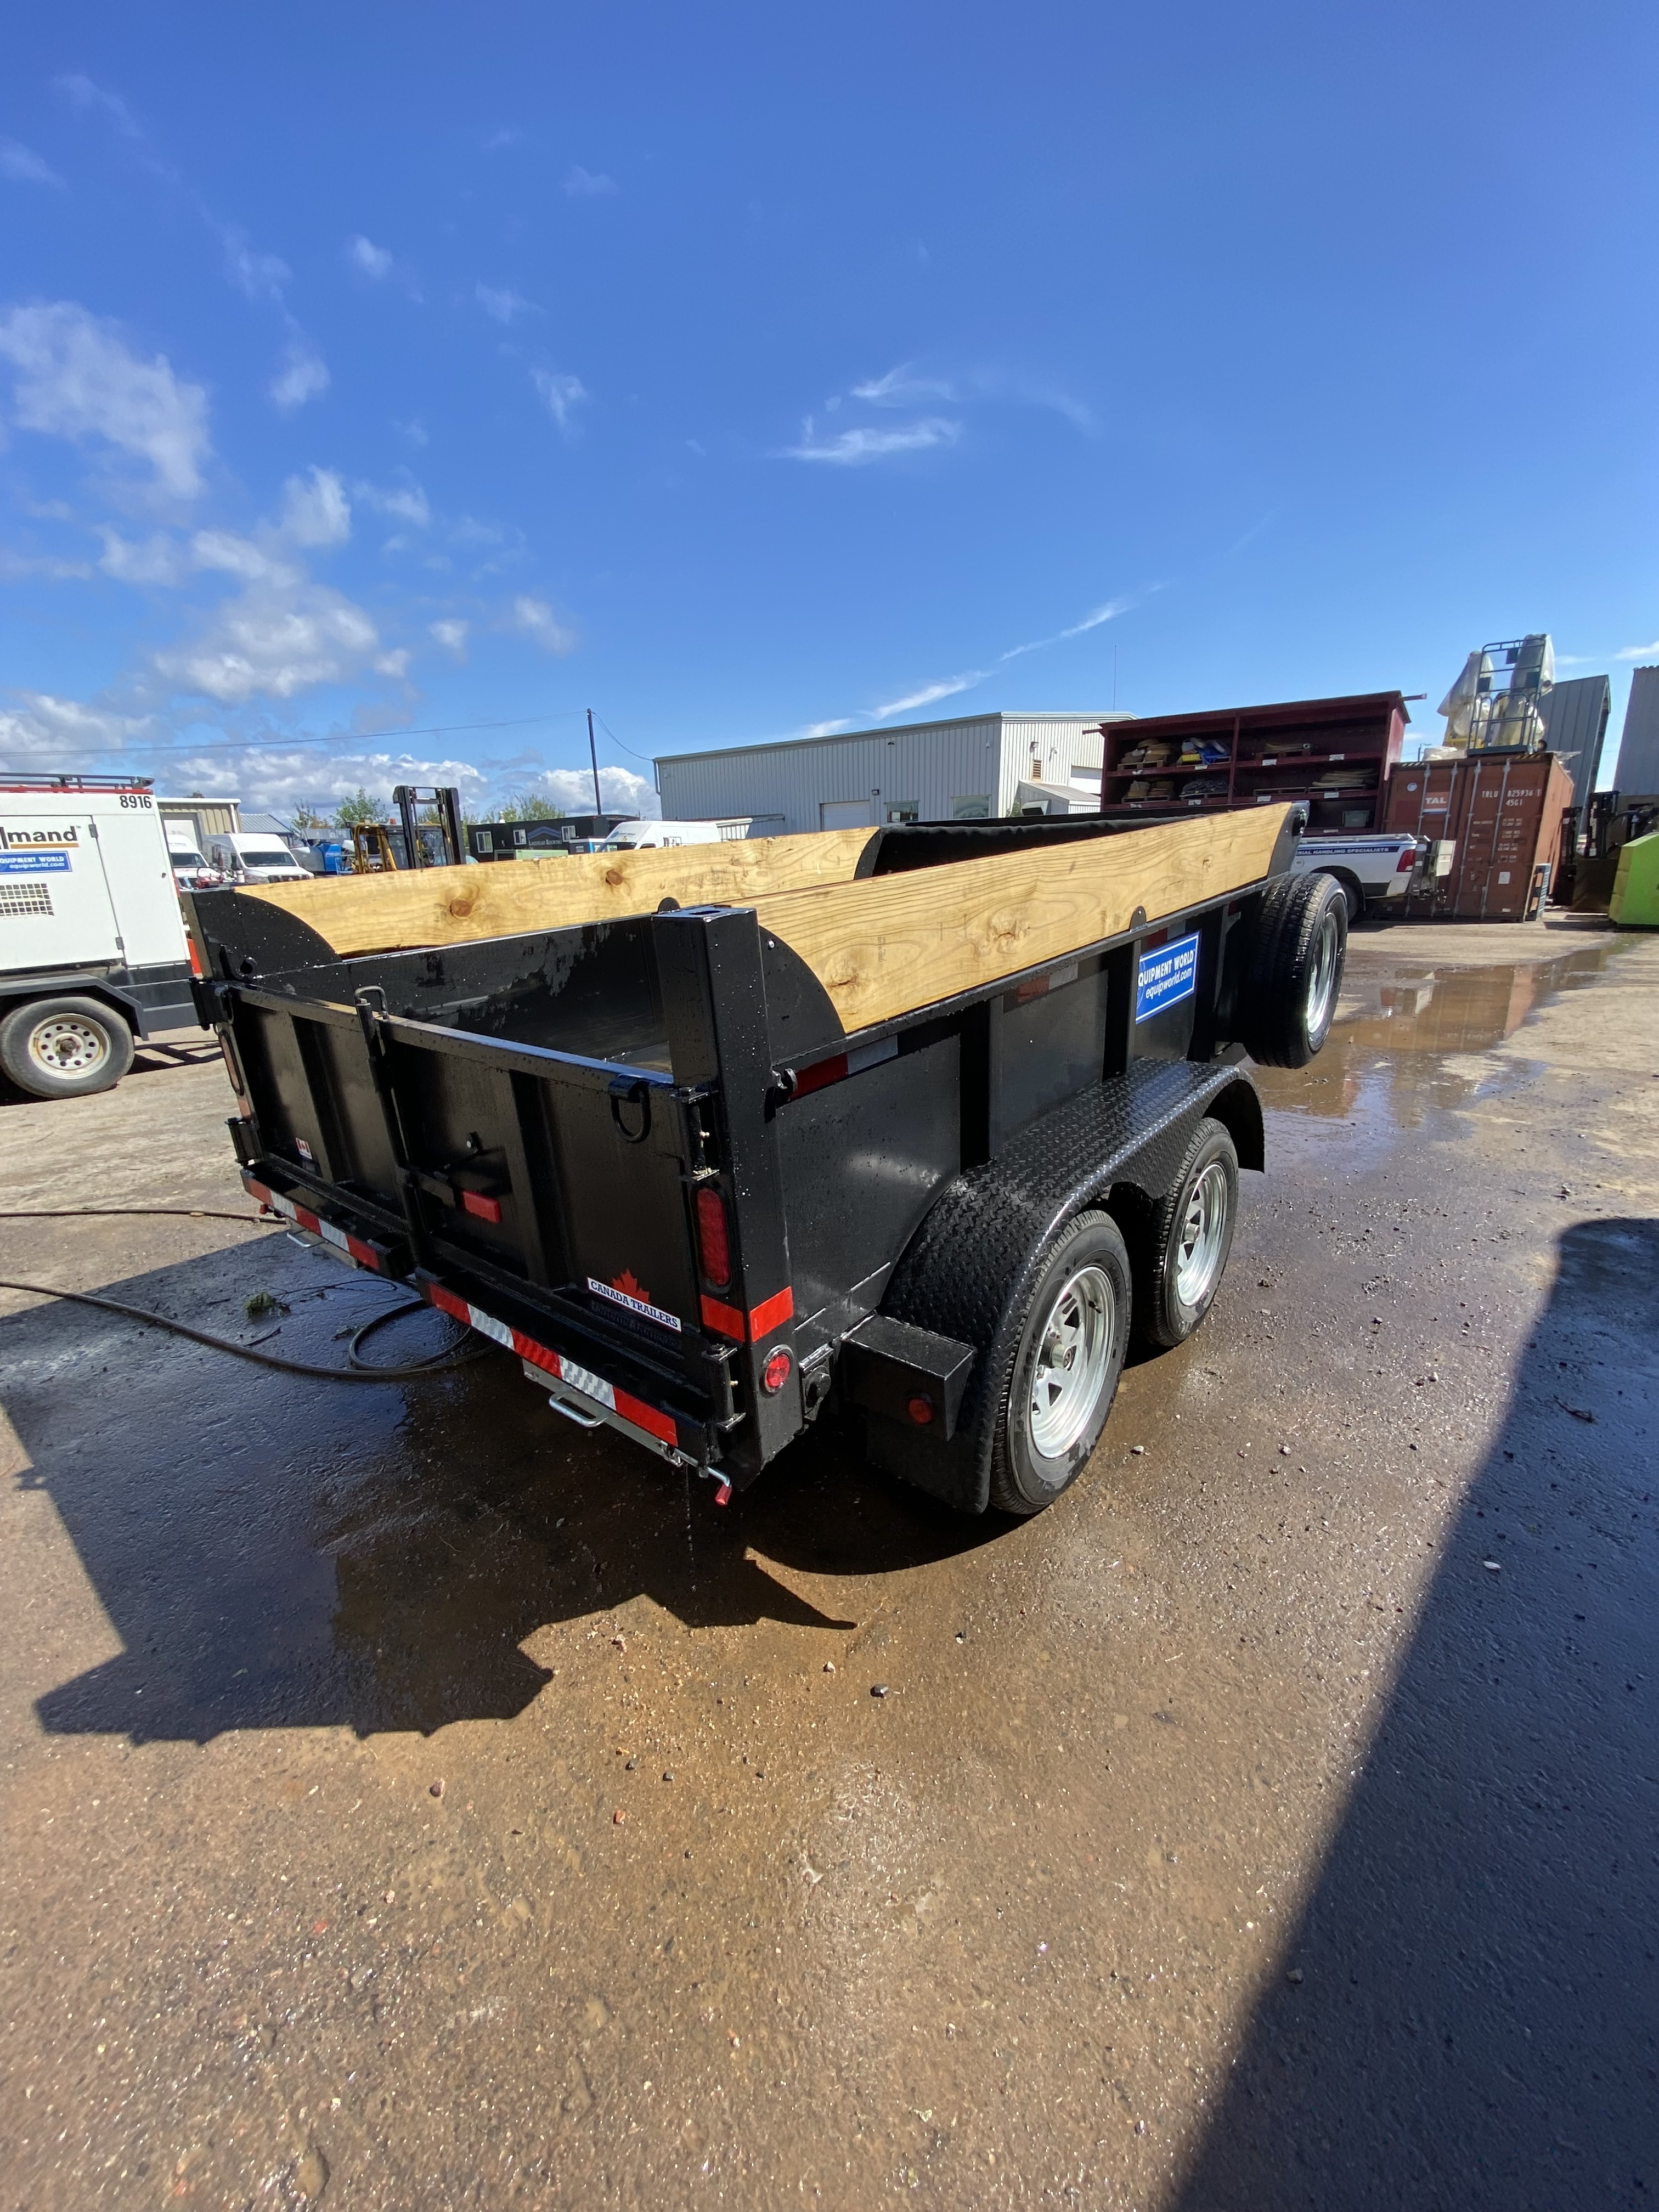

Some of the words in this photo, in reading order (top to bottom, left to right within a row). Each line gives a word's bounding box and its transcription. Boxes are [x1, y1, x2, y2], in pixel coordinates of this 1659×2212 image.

[120, 795, 152, 809] 8916
[1507, 789, 1533, 798] 825936
[0, 826, 77, 849] lmand
[1138, 959, 1172, 987] QUIPMENT
[1173, 950, 1194, 970] WORLD
[1145, 967, 1192, 1000] equipworld.com
[591, 1281, 630, 1306] CANADA
[630, 1299, 678, 1328] TRAILERS
